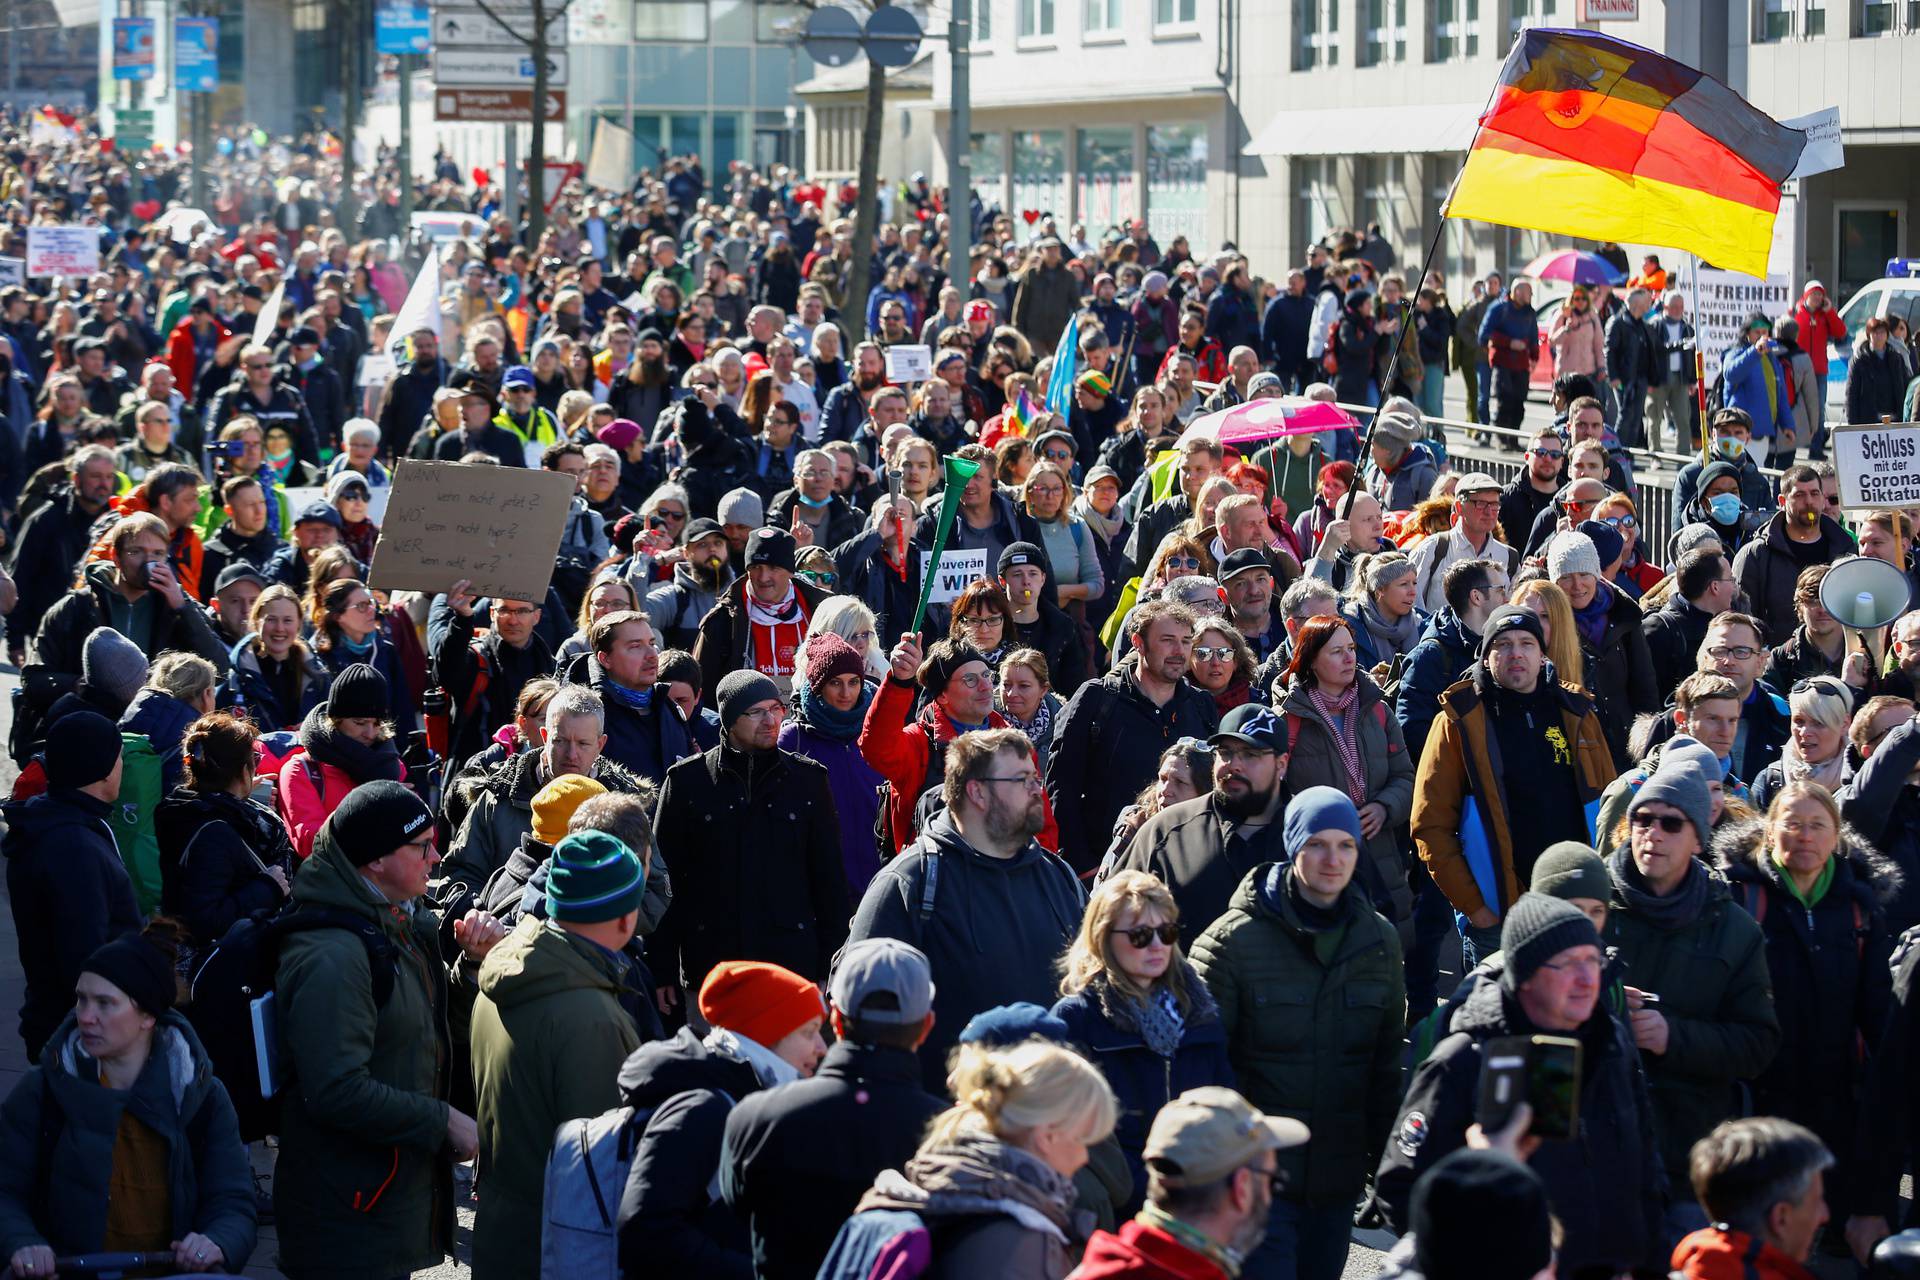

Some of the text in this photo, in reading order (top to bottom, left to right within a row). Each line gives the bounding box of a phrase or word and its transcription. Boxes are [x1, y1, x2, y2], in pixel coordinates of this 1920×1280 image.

[1590, 0, 1634, 12] TRAINING
[1700, 284, 1713, 293] DIE
[1714, 284, 1789, 302] FREIHEIT
[1700, 301, 1741, 311] AUFGIBT
[1861, 433, 1915, 460] Schluss
[1874, 459, 1907, 472] mit der
[1859, 473, 1920, 488] Corona
[1860, 486, 1920, 502] Diktatu
[403, 814, 426, 834] Eisbär
